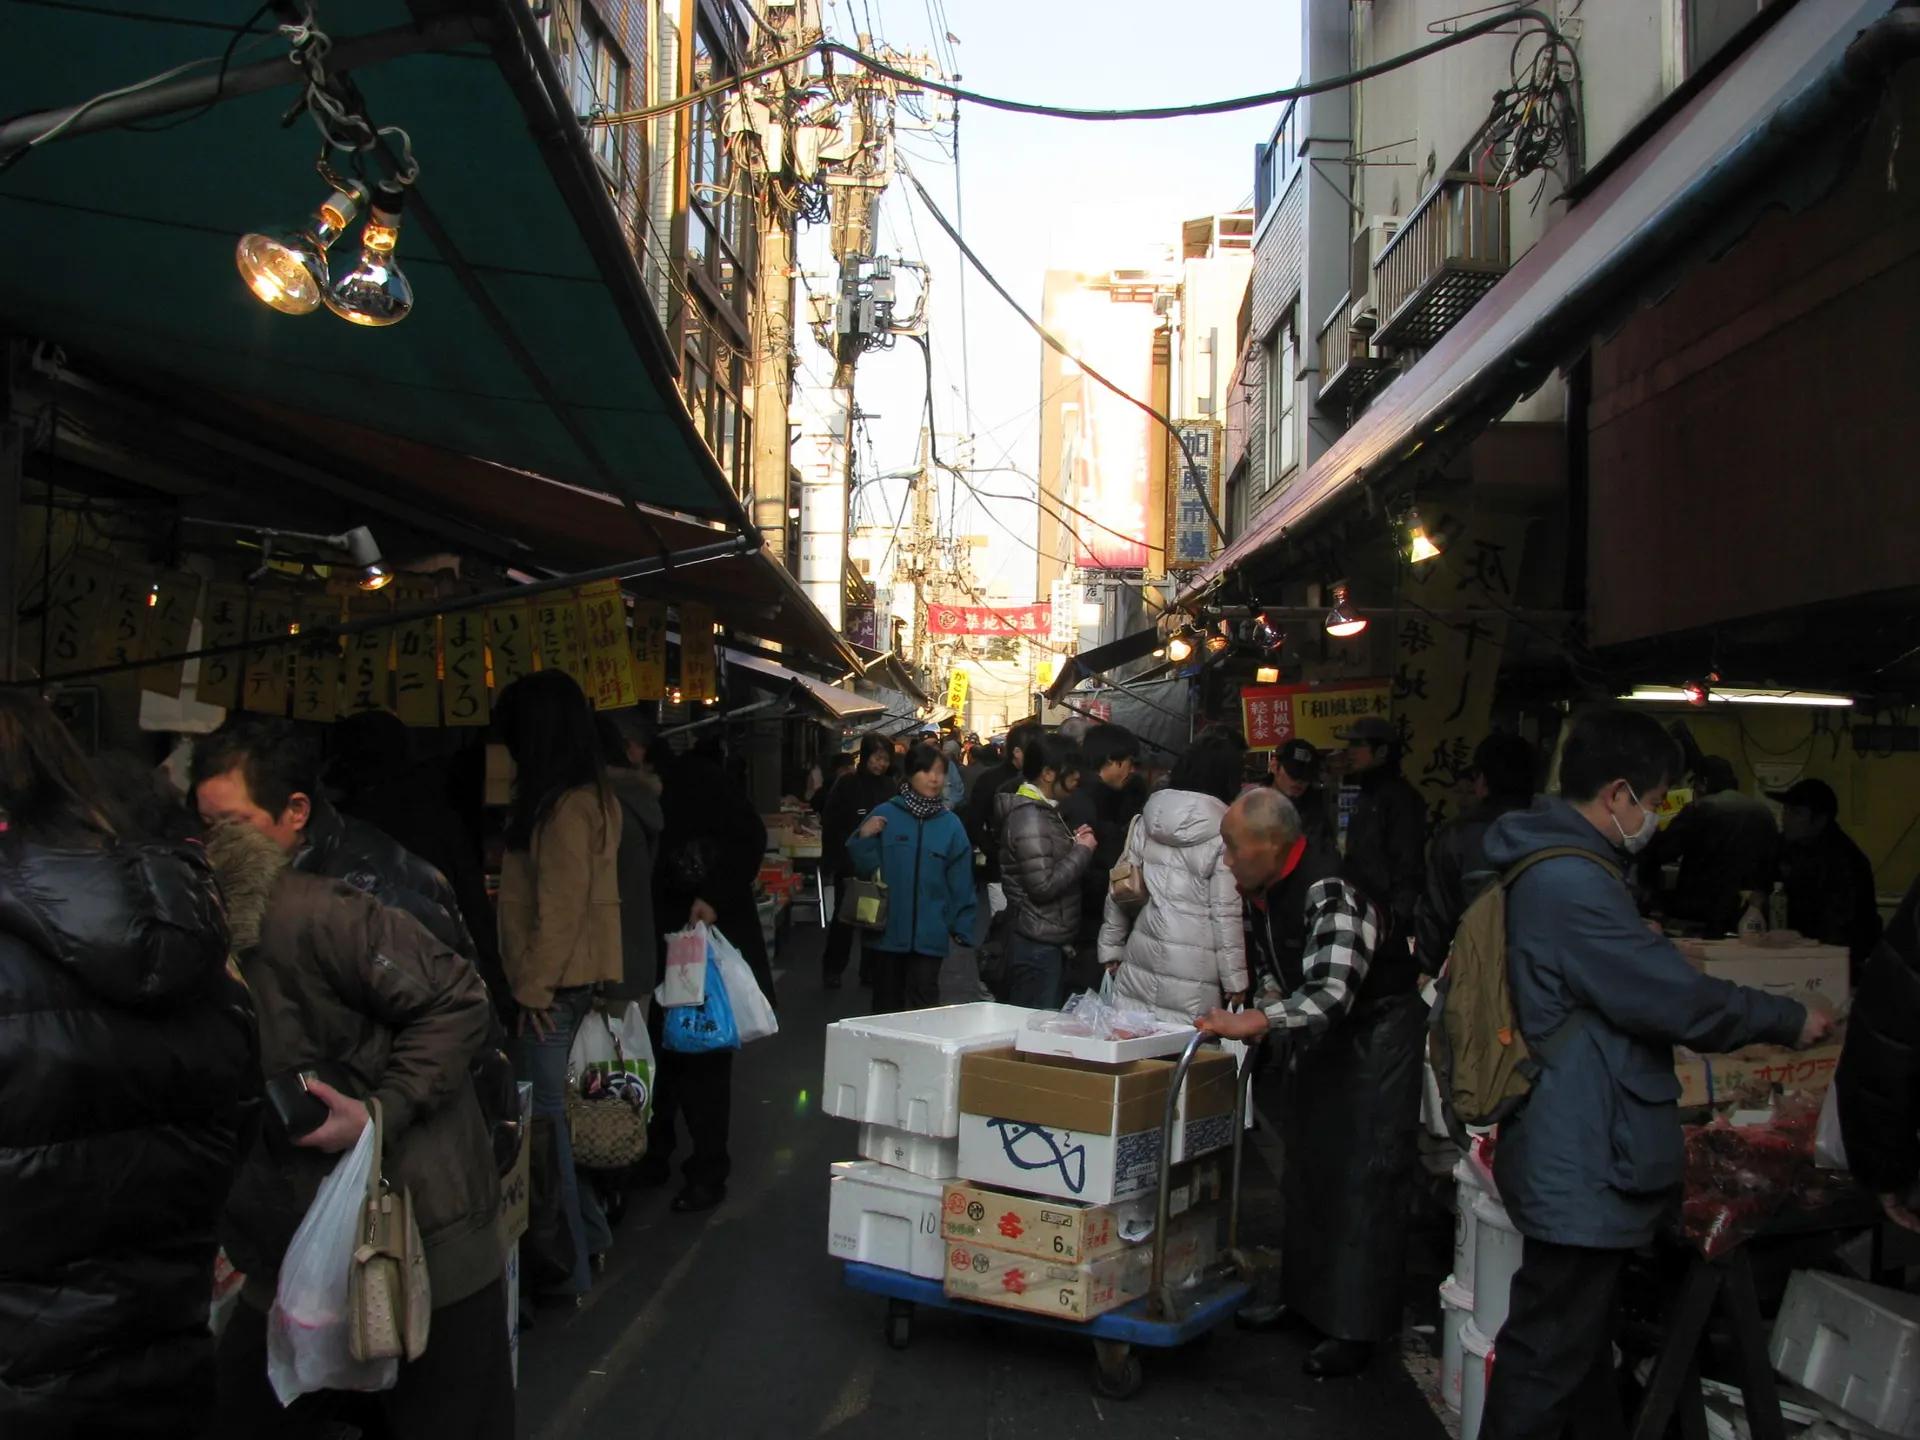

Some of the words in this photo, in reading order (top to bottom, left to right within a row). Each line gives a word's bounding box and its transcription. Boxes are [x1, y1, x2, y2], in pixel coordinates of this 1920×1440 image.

[55, 574, 96, 660] いくら
[539, 607, 560, 665] ほたて
[964, 613, 1051, 631] 築地西通り
[400, 631, 424, 691] カニ
[450, 617, 478, 717] まぐろ
[1250, 701, 1268, 740] 総本家
[1272, 700, 1290, 725] 和風
[919, 1209, 936, 1234] 10
